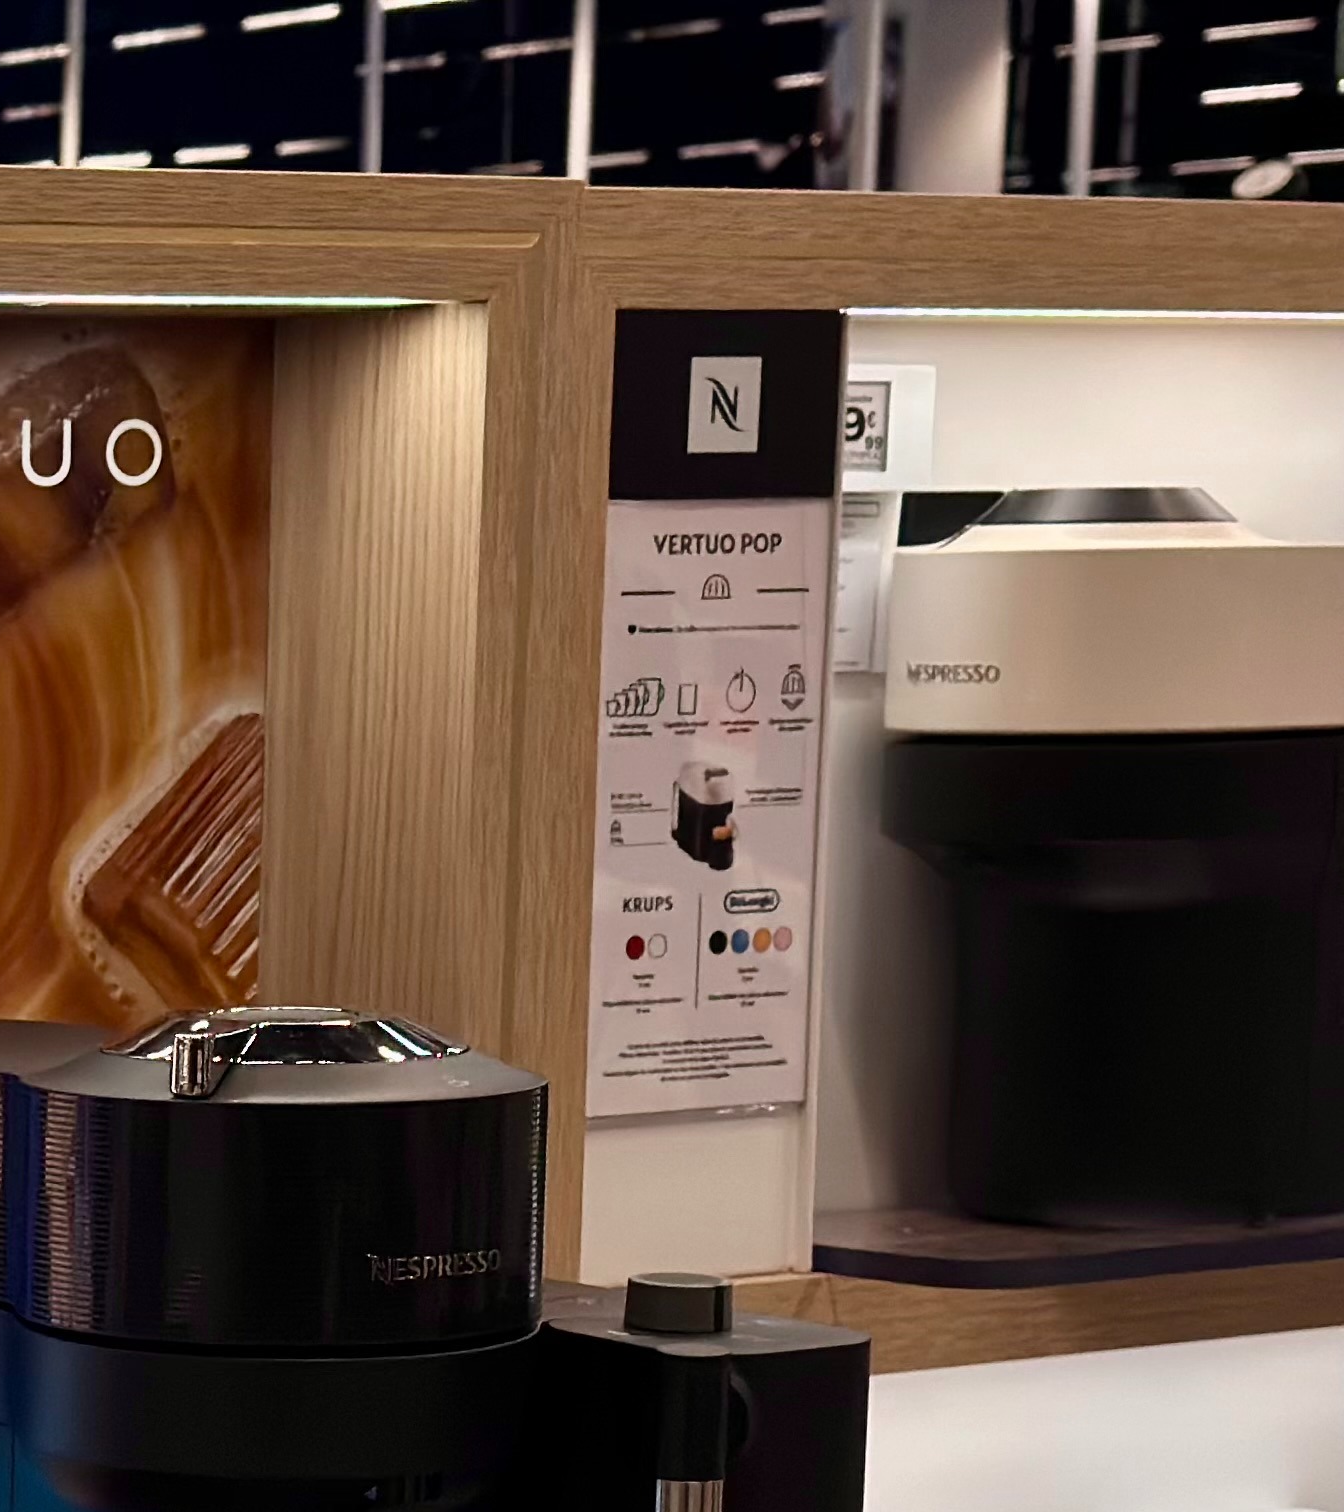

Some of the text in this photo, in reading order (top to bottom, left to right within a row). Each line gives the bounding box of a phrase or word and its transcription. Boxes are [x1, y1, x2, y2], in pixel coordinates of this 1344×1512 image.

[653, 532, 783, 555] VERTUO POP
[907, 659, 1001, 686] NESPRESSO
[622, 895, 674, 913] KRUPS
[366, 1249, 501, 1285] NESPRESSO
